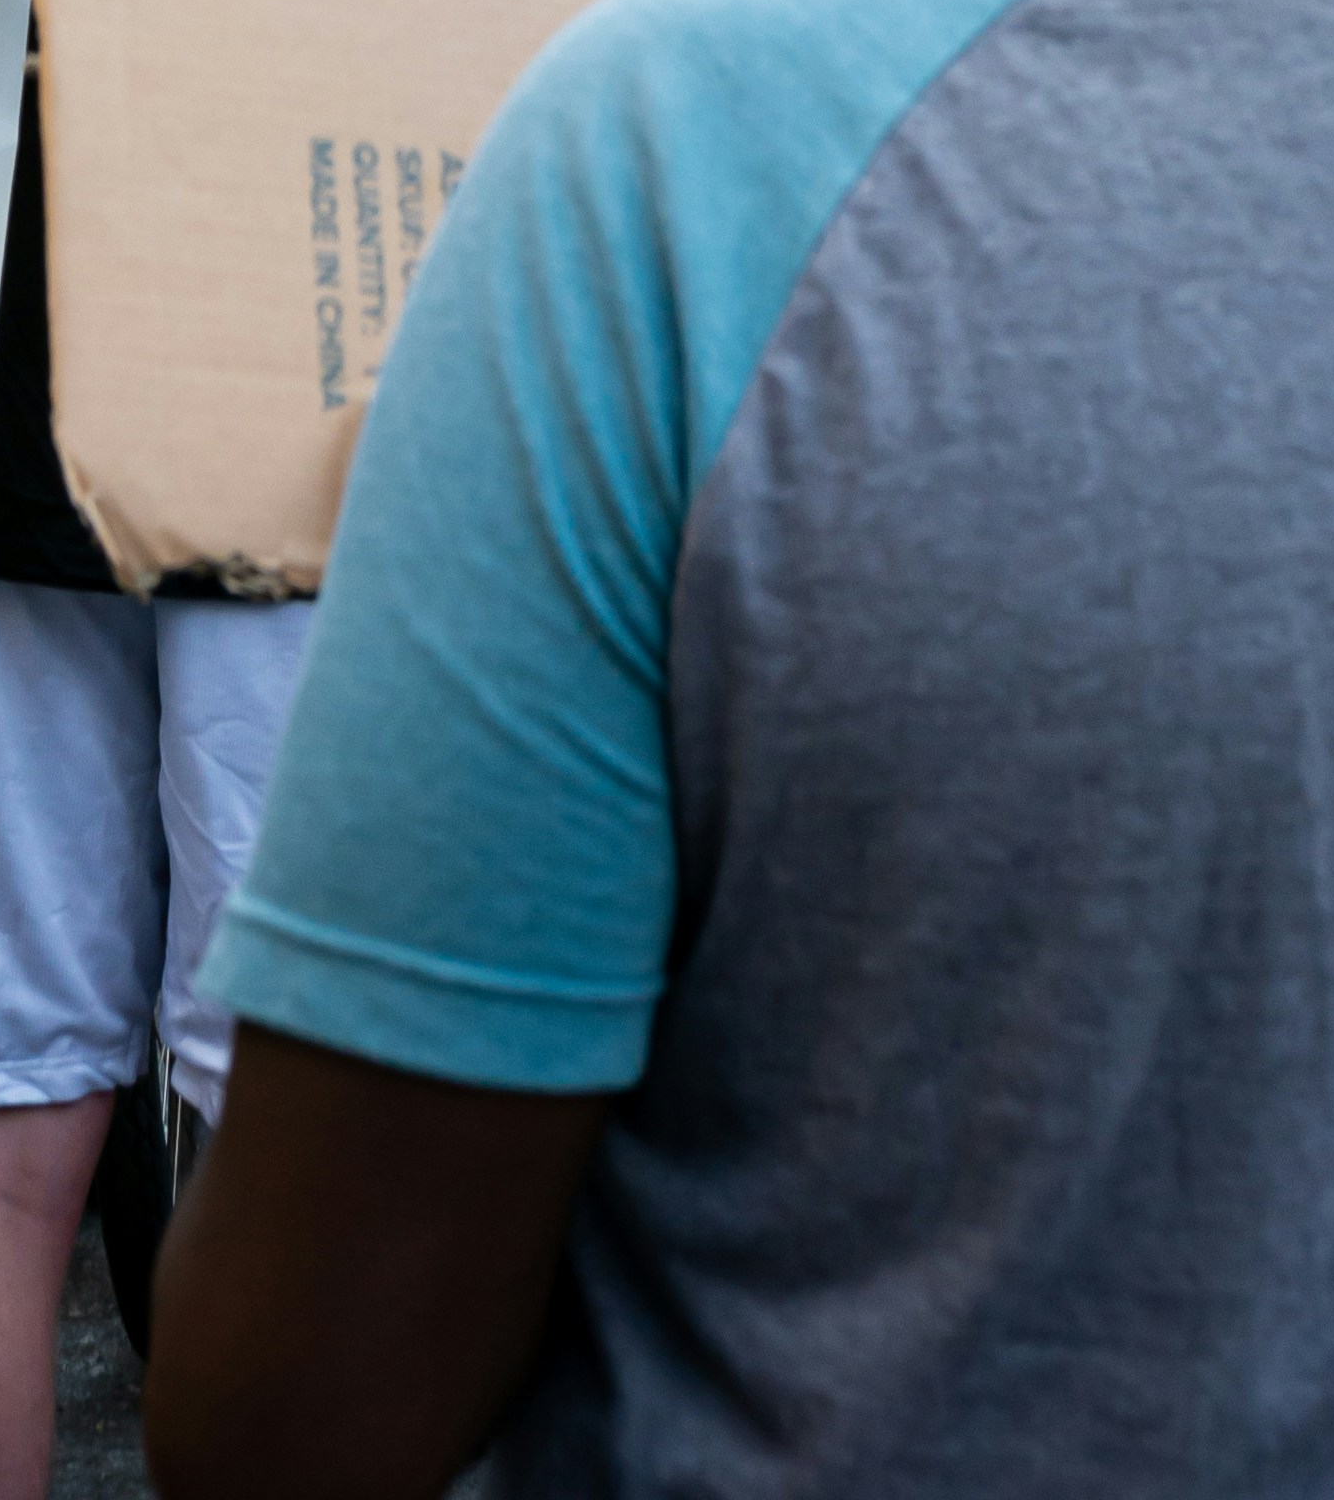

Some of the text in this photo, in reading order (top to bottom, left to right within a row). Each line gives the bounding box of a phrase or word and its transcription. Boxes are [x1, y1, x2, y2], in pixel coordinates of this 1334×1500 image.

[310, 137, 347, 411] MADE IN CHINA
